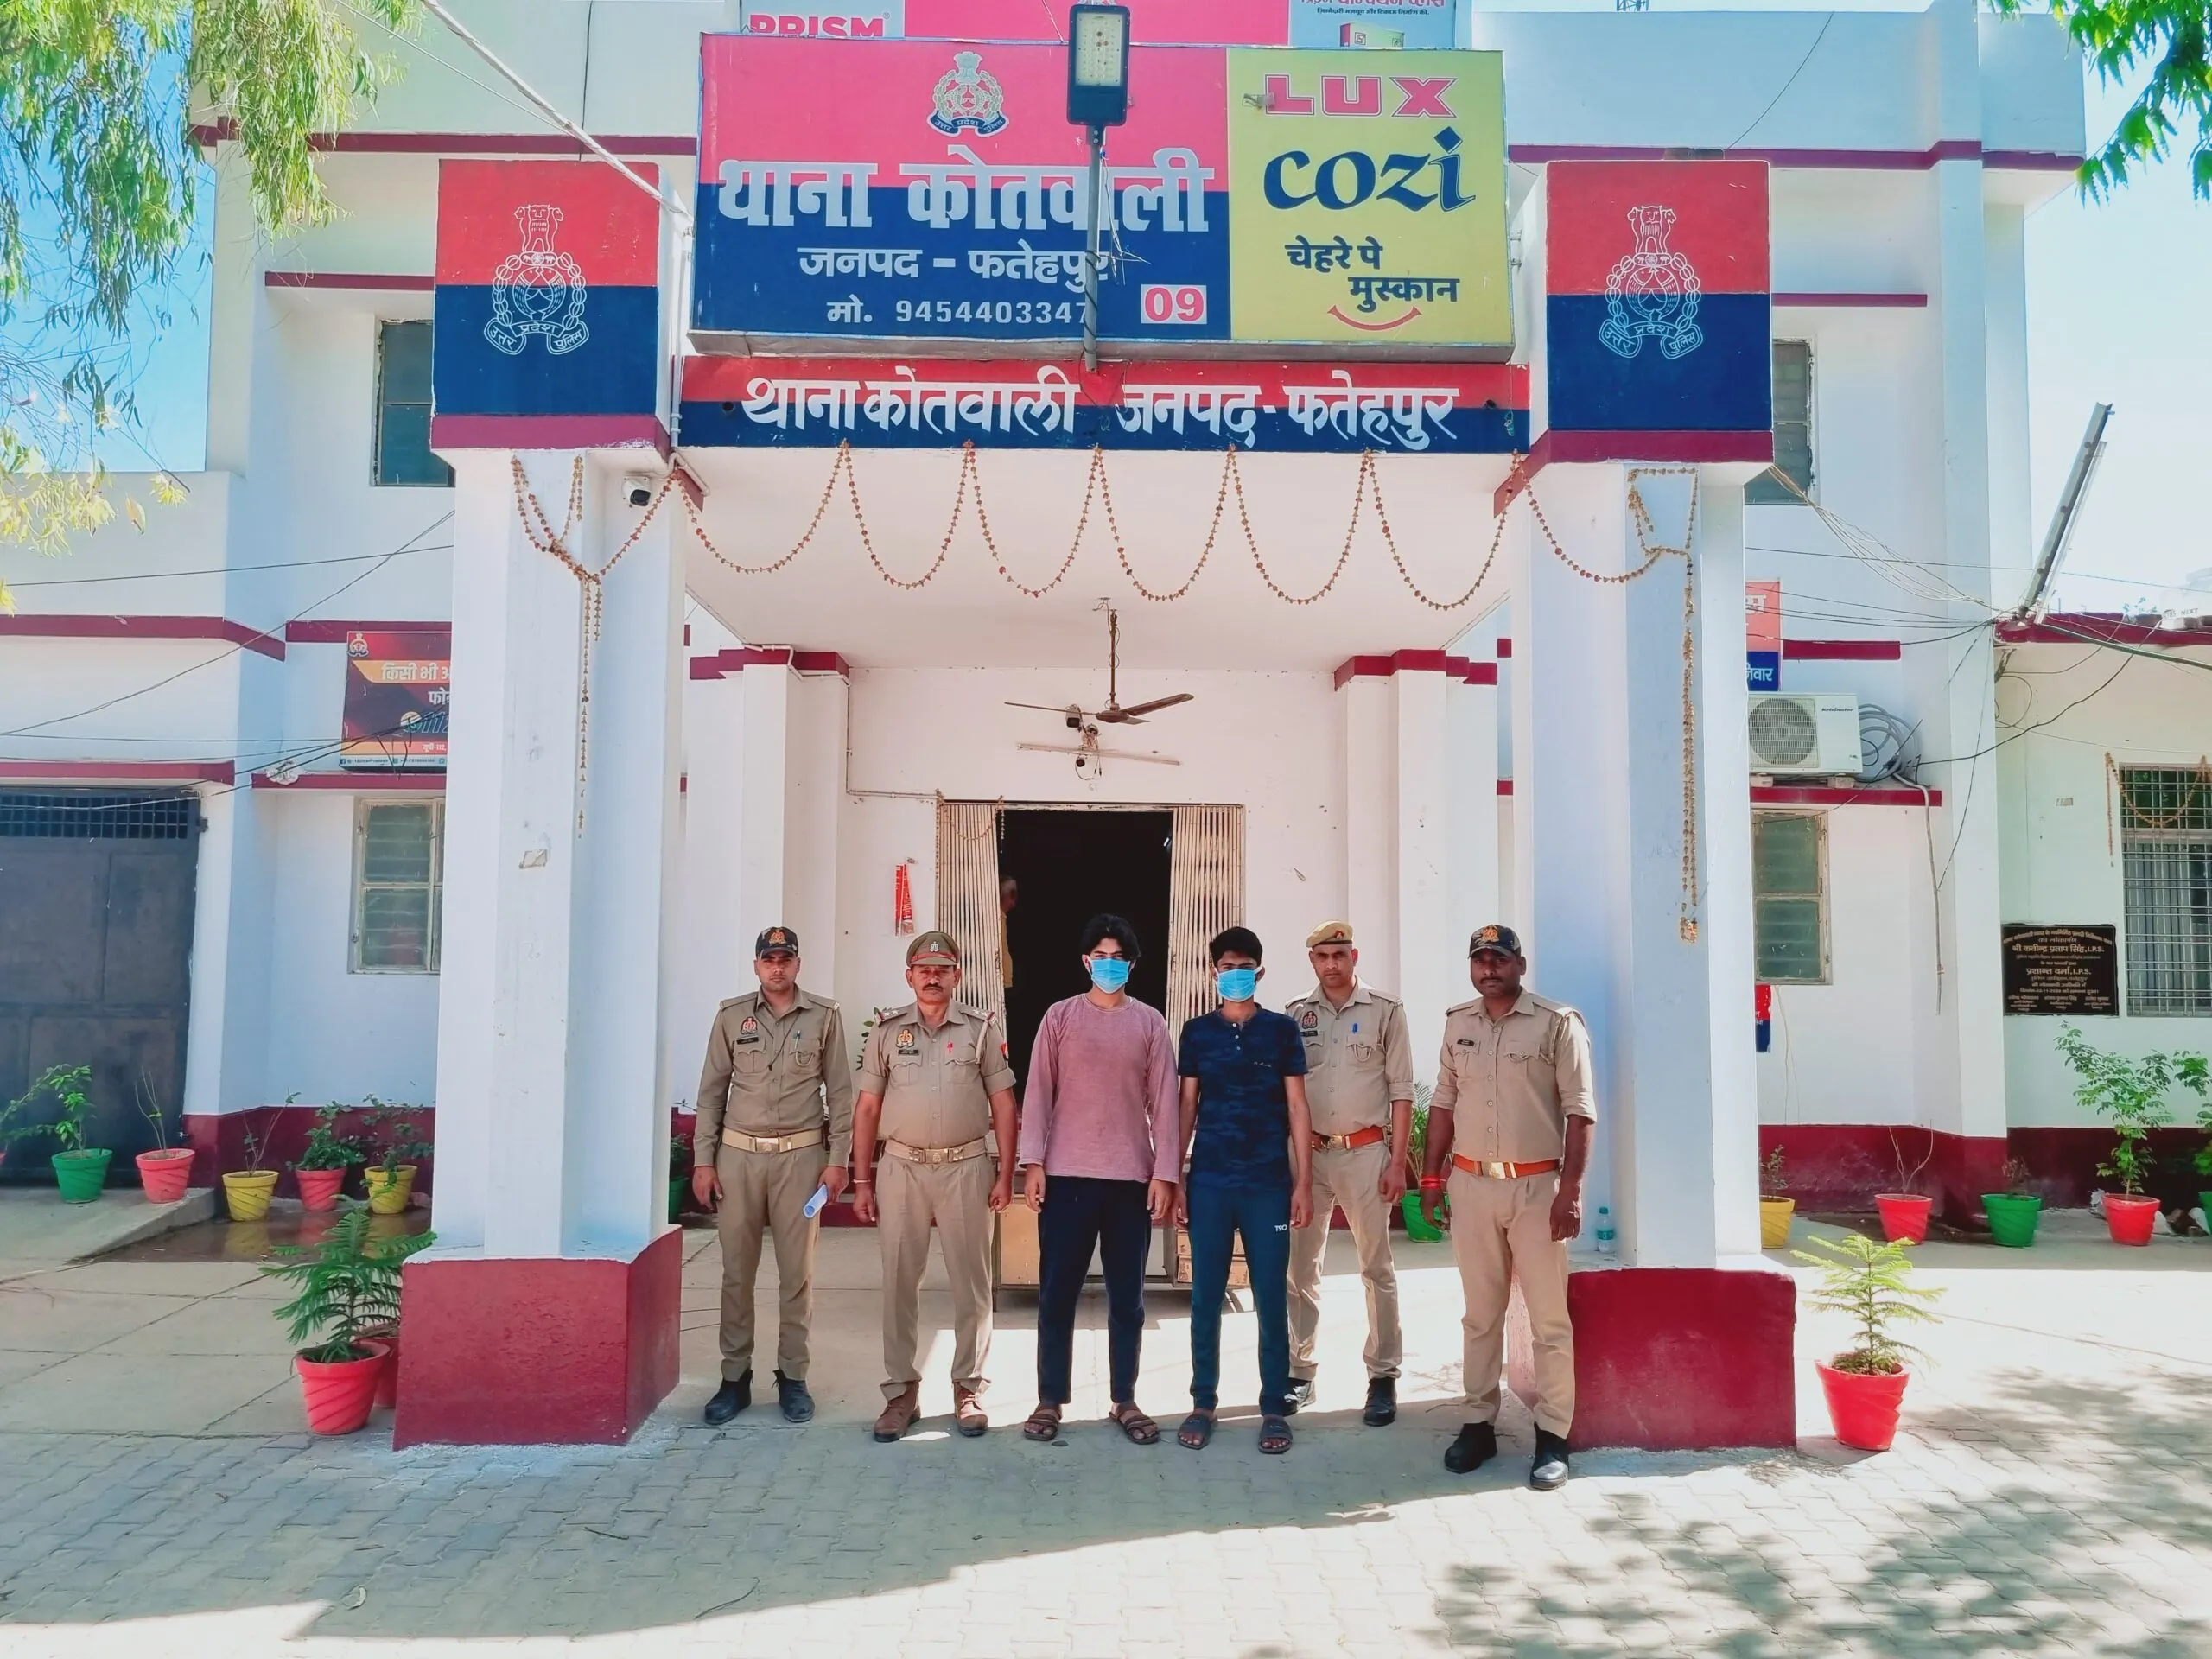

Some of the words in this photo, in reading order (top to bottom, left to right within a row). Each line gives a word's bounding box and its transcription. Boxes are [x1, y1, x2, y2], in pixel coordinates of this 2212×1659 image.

[1264, 74, 1459, 118] LUX
[718, 159, 879, 228] थाना
[899, 144, 1215, 232] कोतवाली
[1263, 125, 1477, 213] cozi
[797, 247, 923, 278] जनपद
[968, 238, 1111, 294] फतेहपुर
[1284, 234, 1353, 273] चेहरे
[1357, 235, 1383, 270] पे
[826, 294, 873, 323] मो.
[1144, 286, 1205, 321] 09
[1347, 276, 1460, 313] मुस्कान
[741, 377, 861, 431] थाना
[864, 365, 1082, 436] कोतवाली
[381, 662, 416, 681] किसी
[420, 662, 438, 681] भी
